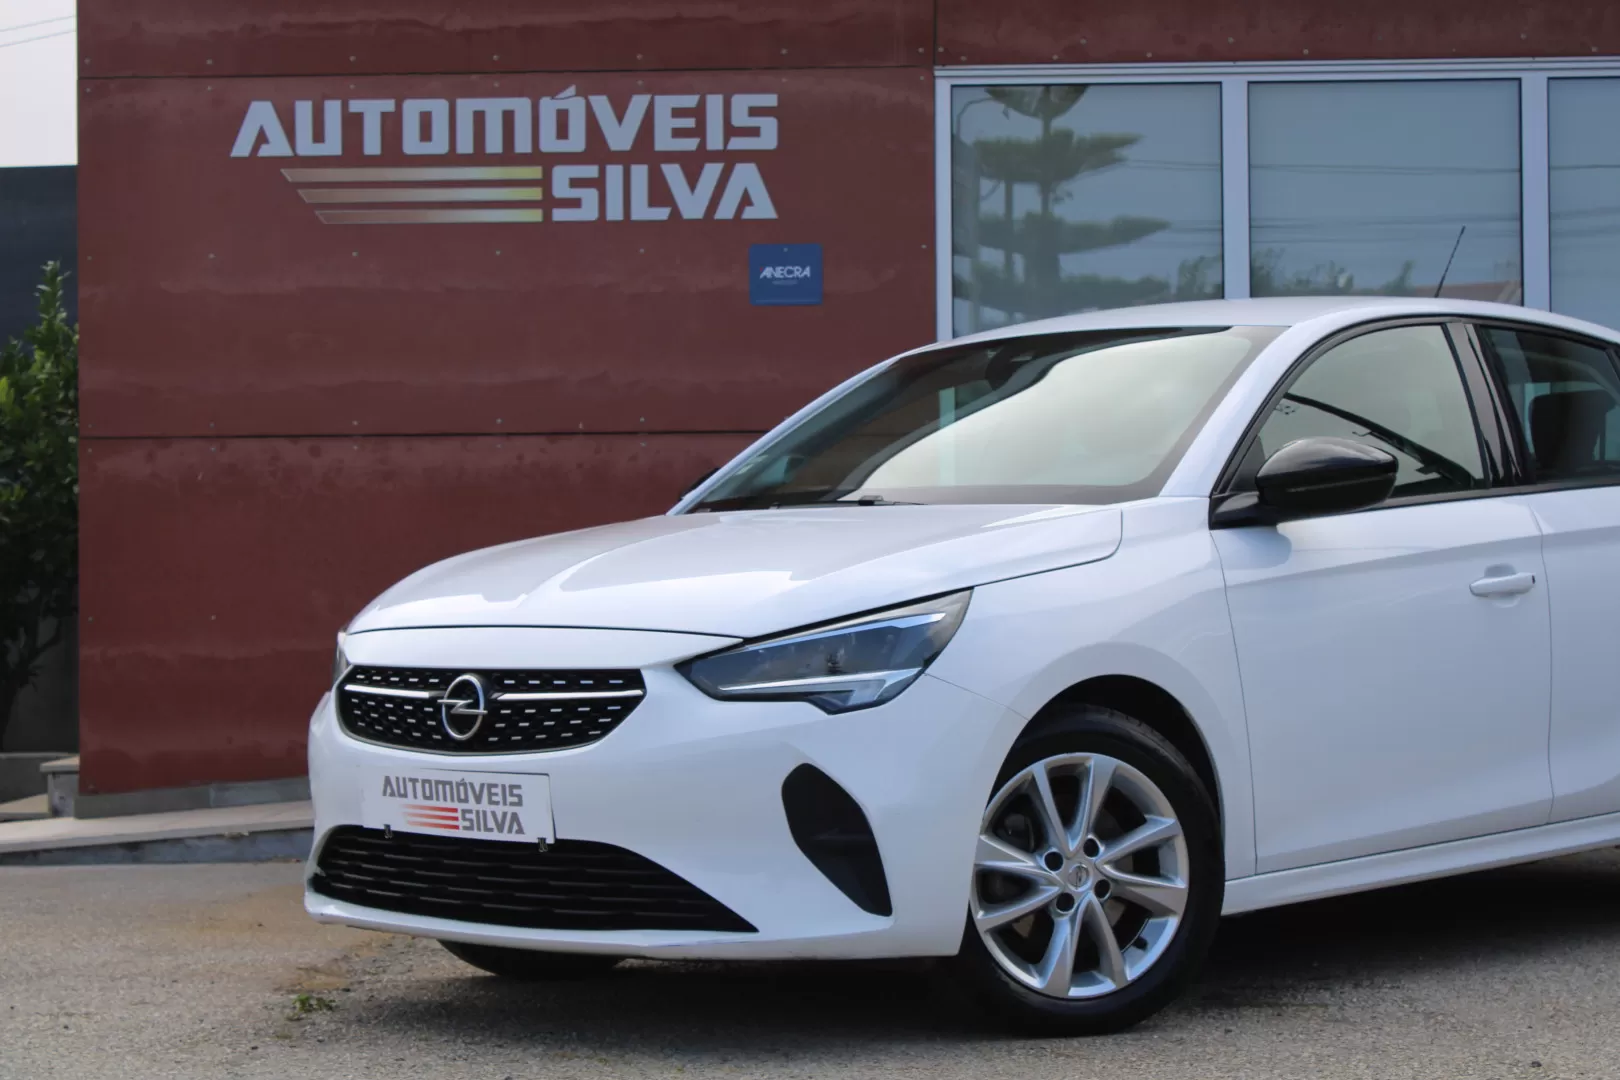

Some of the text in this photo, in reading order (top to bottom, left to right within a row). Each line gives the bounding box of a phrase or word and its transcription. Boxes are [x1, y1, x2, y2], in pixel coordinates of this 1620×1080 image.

[230, 84, 778, 157] AUTOMÓVEIS
[551, 162, 778, 221] SILVA
[760, 265, 811, 279] ANECRA
[382, 775, 523, 807] AUTOMÓVEIS
[460, 809, 525, 835] SILVA
